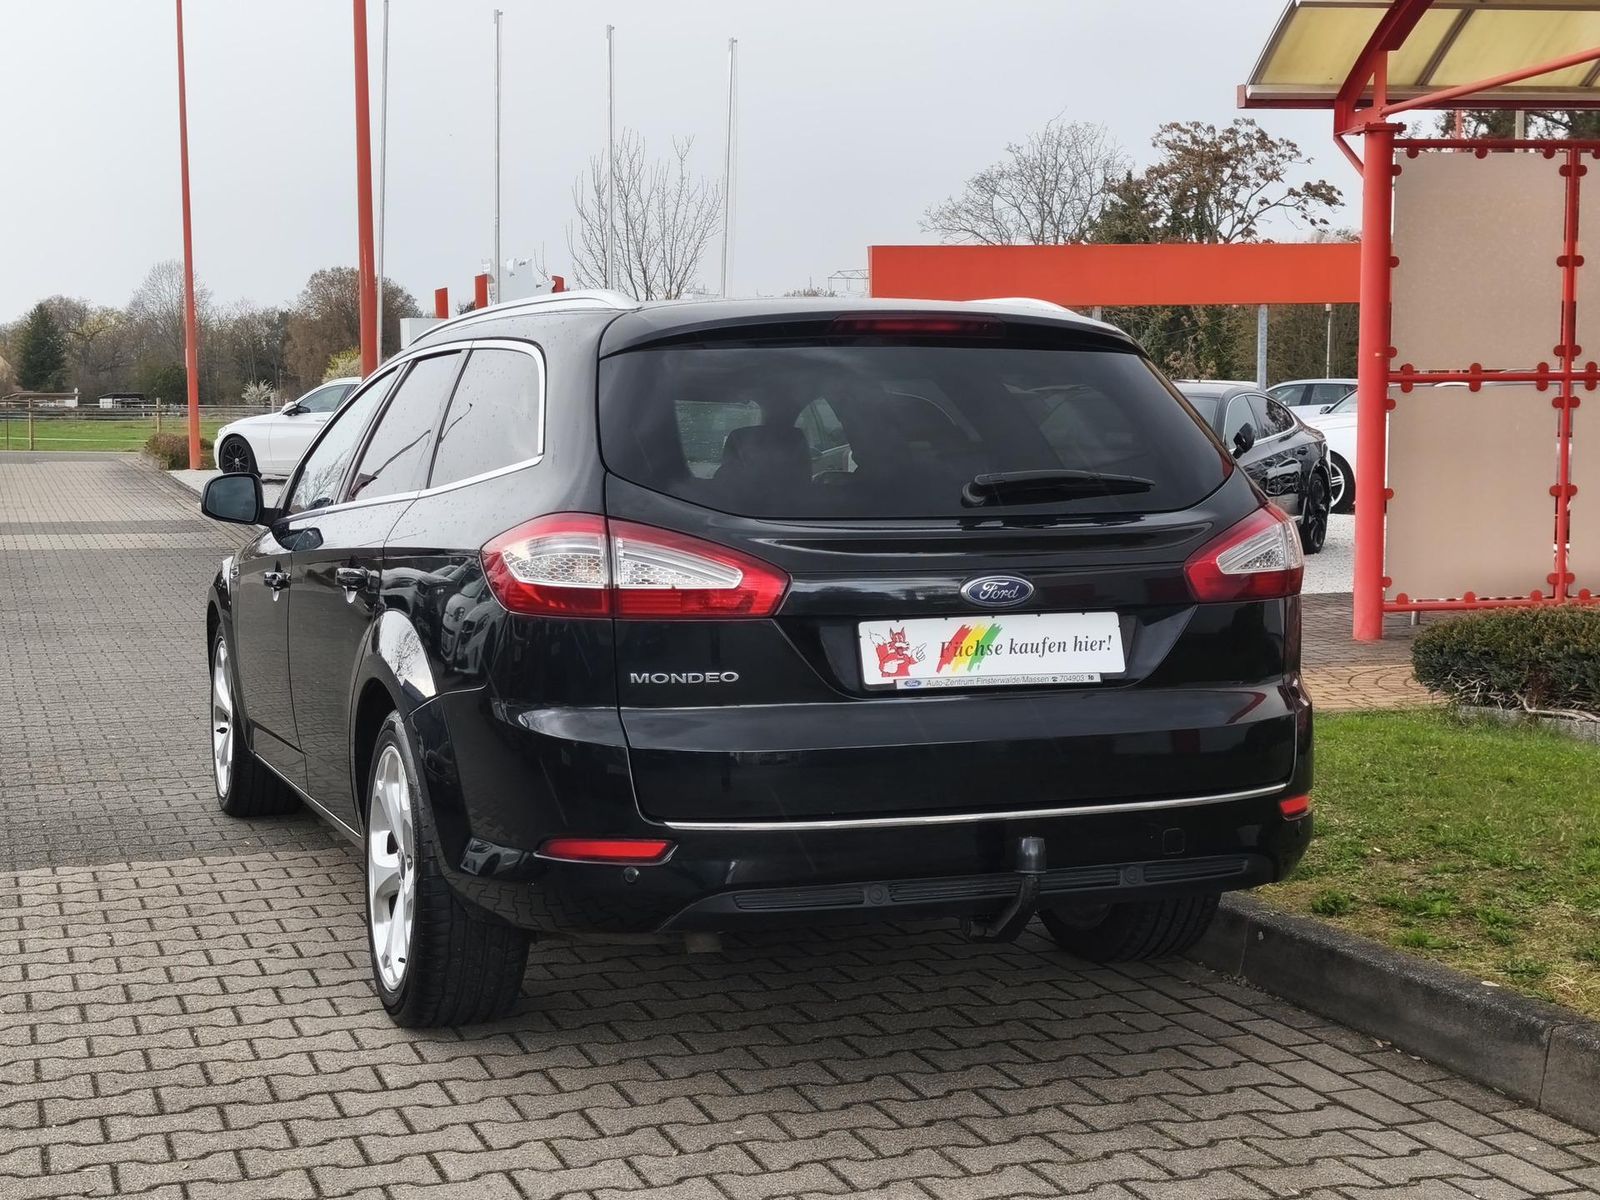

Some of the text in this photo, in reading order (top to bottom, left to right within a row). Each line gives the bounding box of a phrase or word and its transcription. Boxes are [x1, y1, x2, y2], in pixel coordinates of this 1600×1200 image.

[979, 581, 1020, 600] Ford
[940, 634, 1112, 658] Füchse kaufen hier!
[630, 671, 740, 684] MONDEO
[926, 678, 974, 687] Auto-Zentrum
